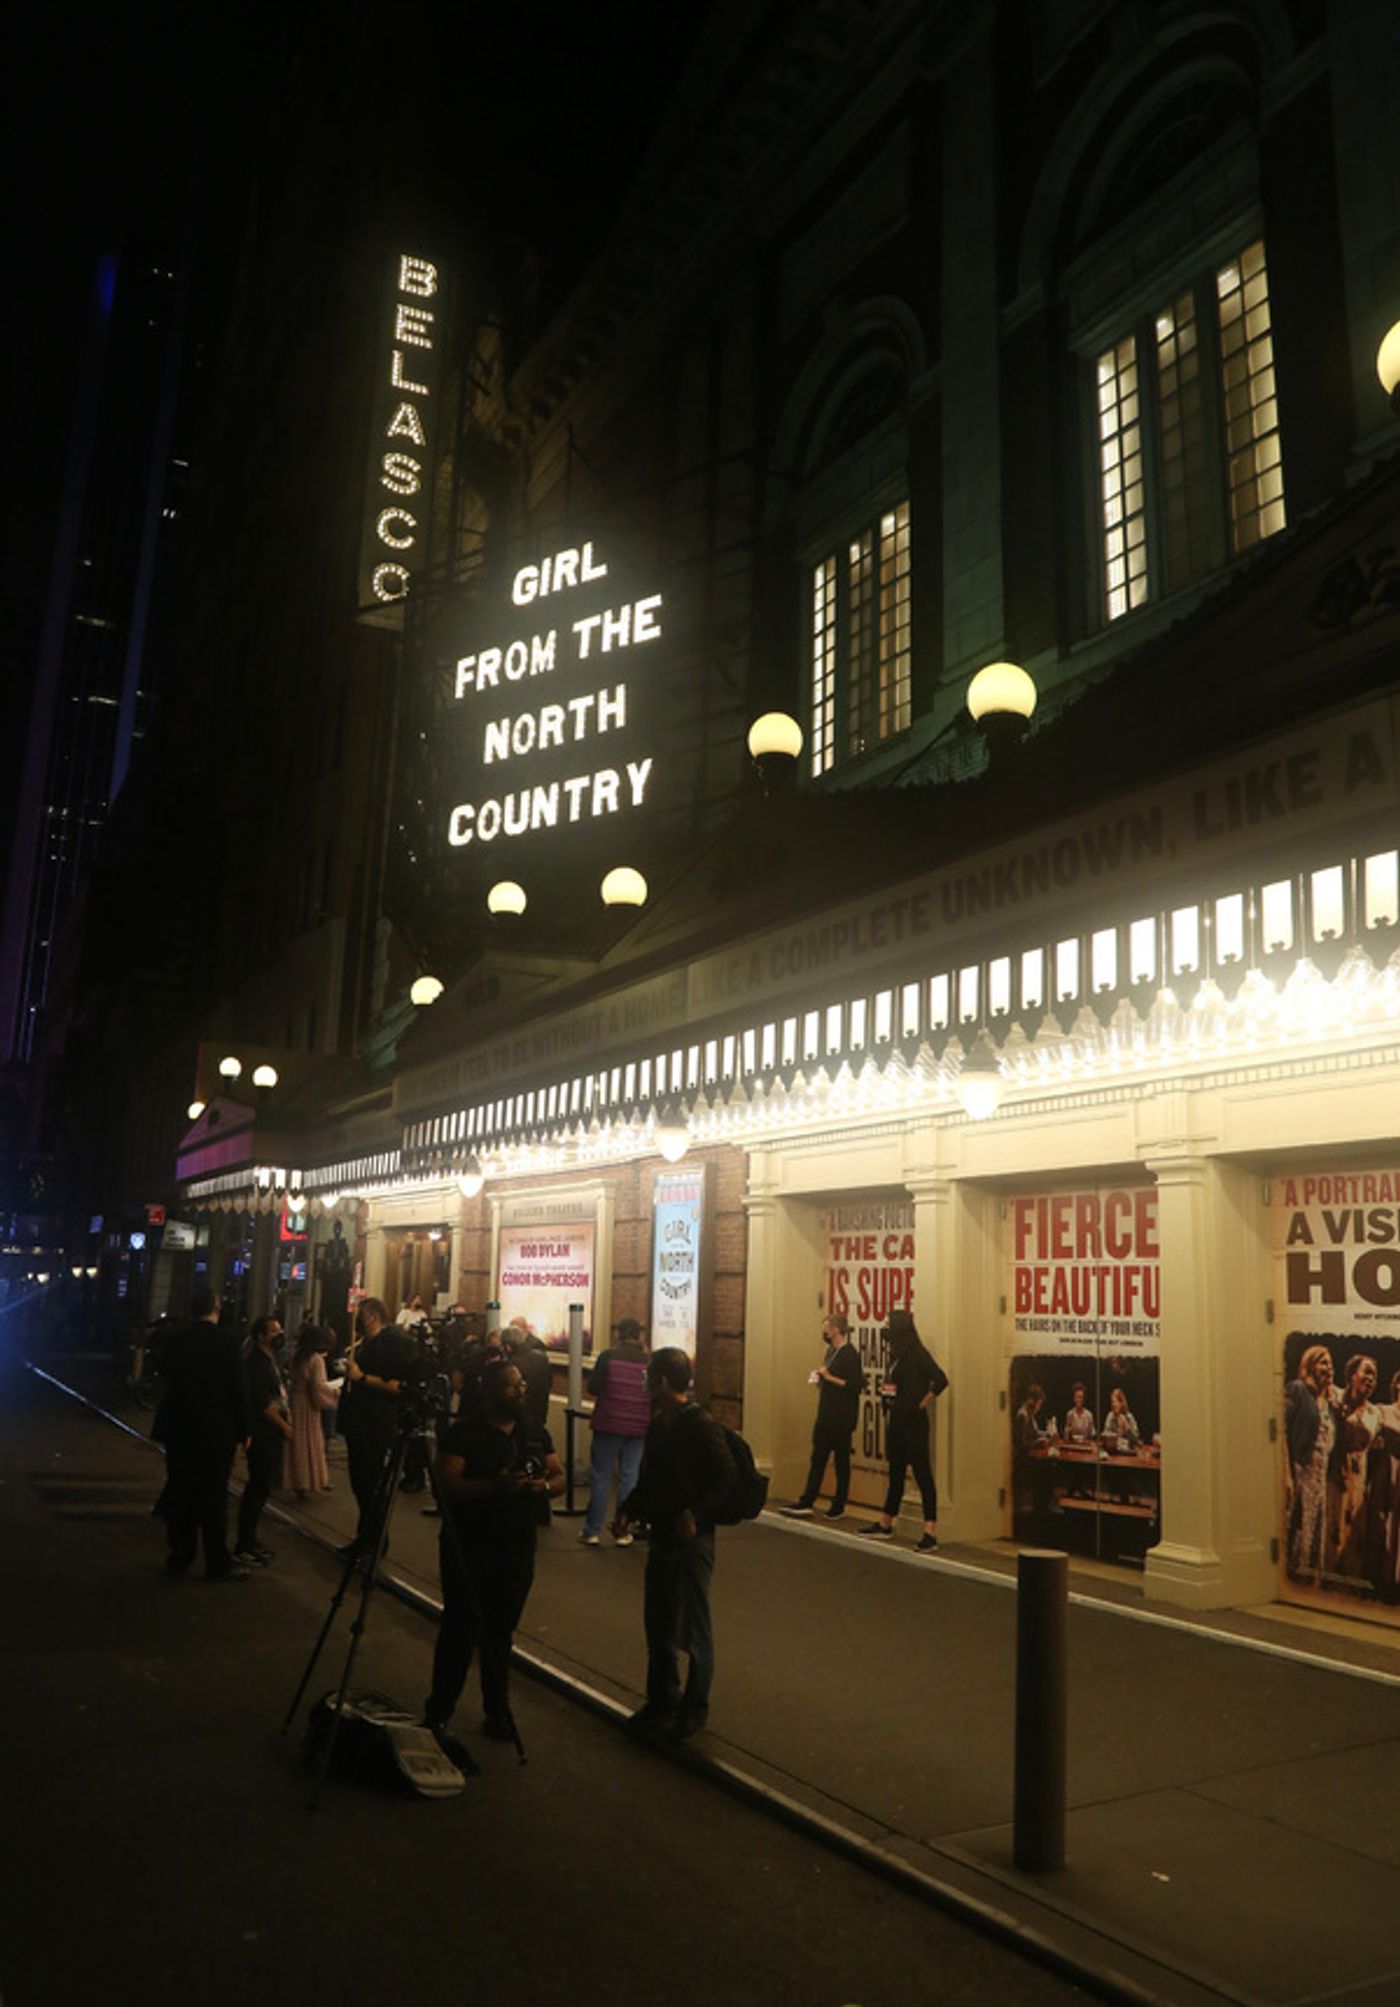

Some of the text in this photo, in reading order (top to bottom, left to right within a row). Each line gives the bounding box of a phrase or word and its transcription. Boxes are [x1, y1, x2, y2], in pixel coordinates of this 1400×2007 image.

[372, 254, 438, 603] BELASCO
[512, 541, 607, 606] GIRL
[455, 594, 663, 700] FROM THE
[483, 683, 627, 764] NORTH
[448, 758, 653, 848] COUNTRY
[770, 890, 930, 982] COMPLETE
[940, 804, 1178, 926] UNKNOWN,
[1190, 748, 1324, 842] LIKE
[1344, 729, 1387, 795] A
[539, 1243, 570, 1258] DYLAN
[829, 1235, 877, 1262] THE
[1286, 1211, 1315, 1245] A
[502, 1272, 531, 1286] CONOR
[829, 1267, 848, 1320] IS
[1015, 1265, 1160, 1319] BEAUTIFU
[1132, 1321, 1154, 1337] NECK
